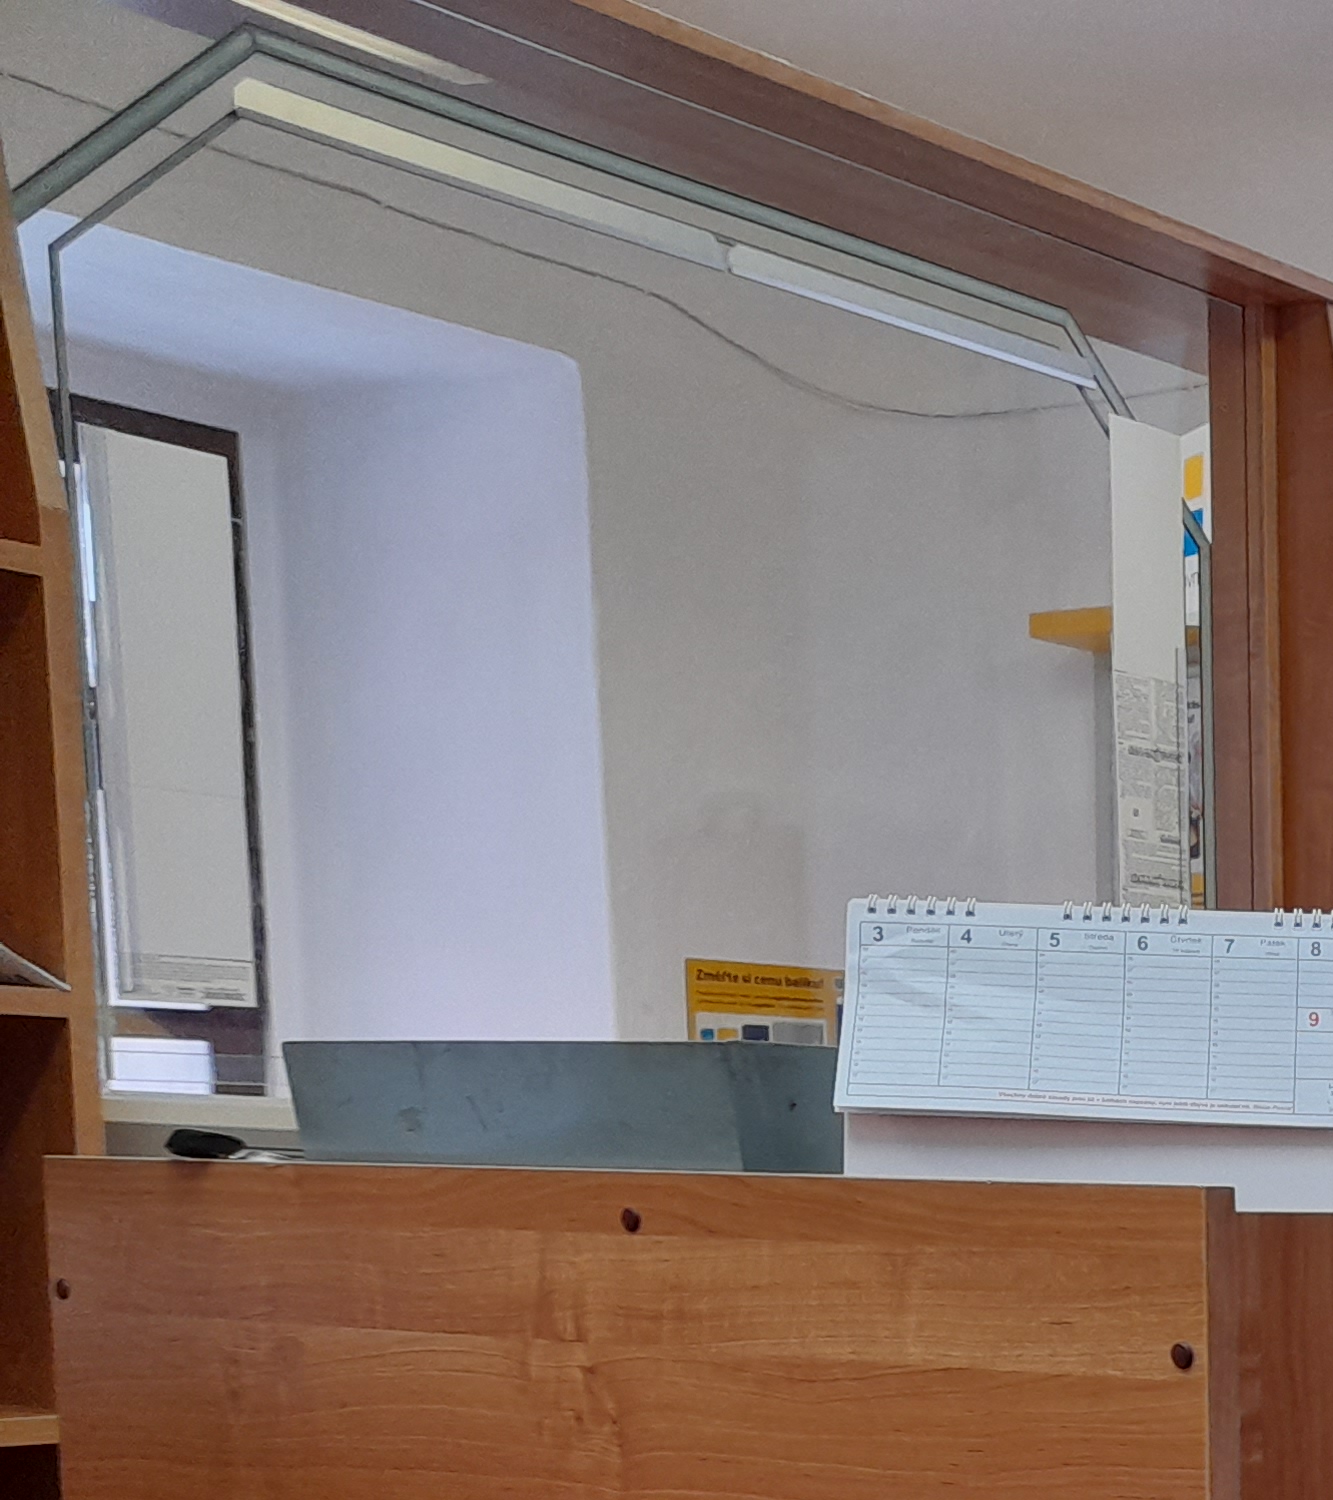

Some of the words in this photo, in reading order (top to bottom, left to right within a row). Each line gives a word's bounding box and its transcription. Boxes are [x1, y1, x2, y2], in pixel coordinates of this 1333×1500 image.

[873, 926, 884, 942] 3
[960, 929, 973, 944] 4
[1049, 932, 1061, 947] 5
[1137, 935, 1149, 951] 6
[1223, 939, 1236, 954] 7
[1310, 941, 1322, 957] 8
[1308, 1011, 1320, 1027] 9
